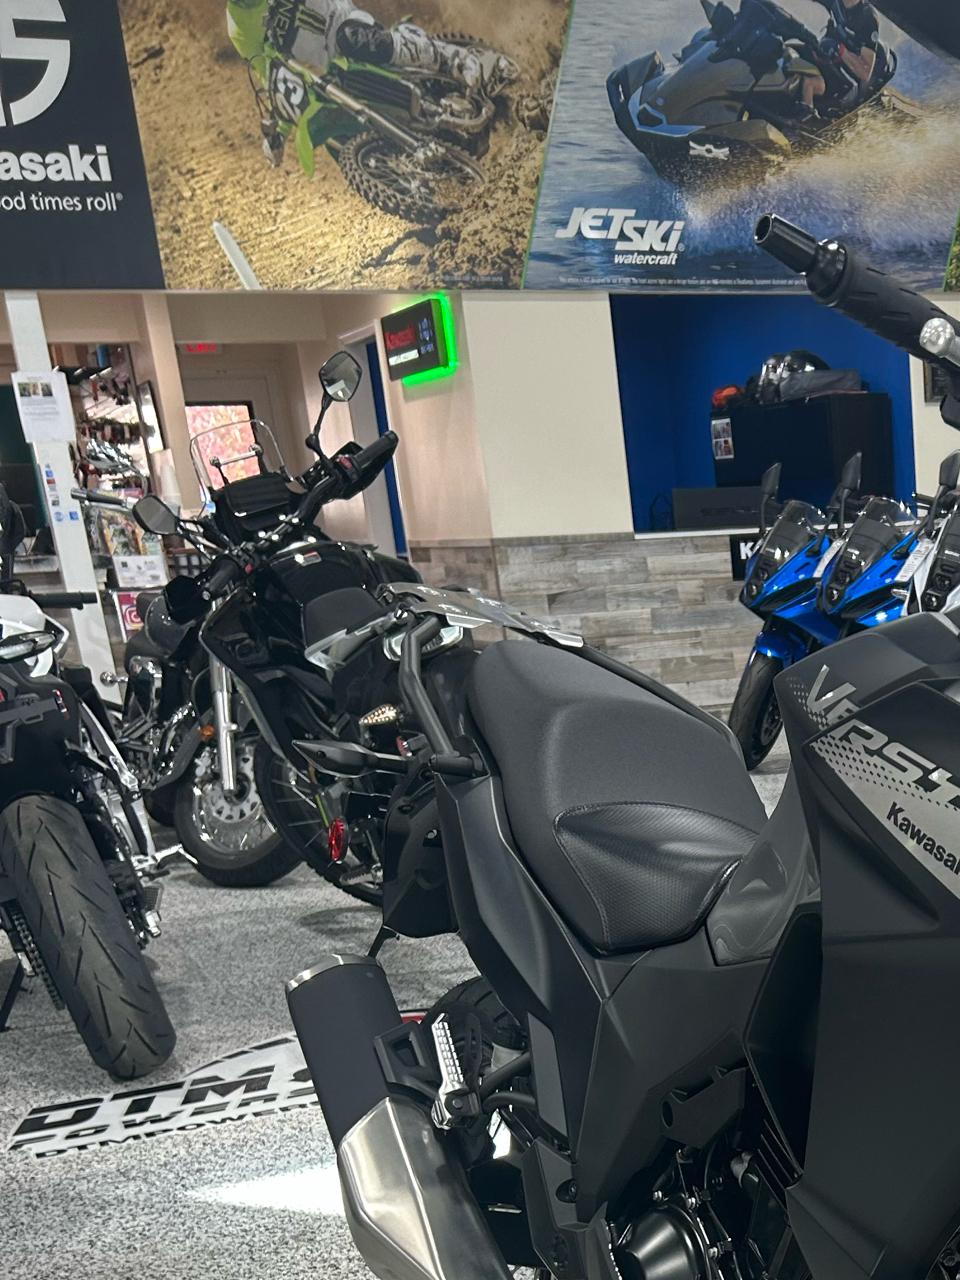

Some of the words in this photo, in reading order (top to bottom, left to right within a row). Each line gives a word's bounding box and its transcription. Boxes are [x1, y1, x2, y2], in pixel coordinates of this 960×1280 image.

[0, 190, 27, 211] od
[30, 190, 83, 211] times
[614, 252, 679, 266] watercraft
[12, 1064, 276, 1137] DTM
